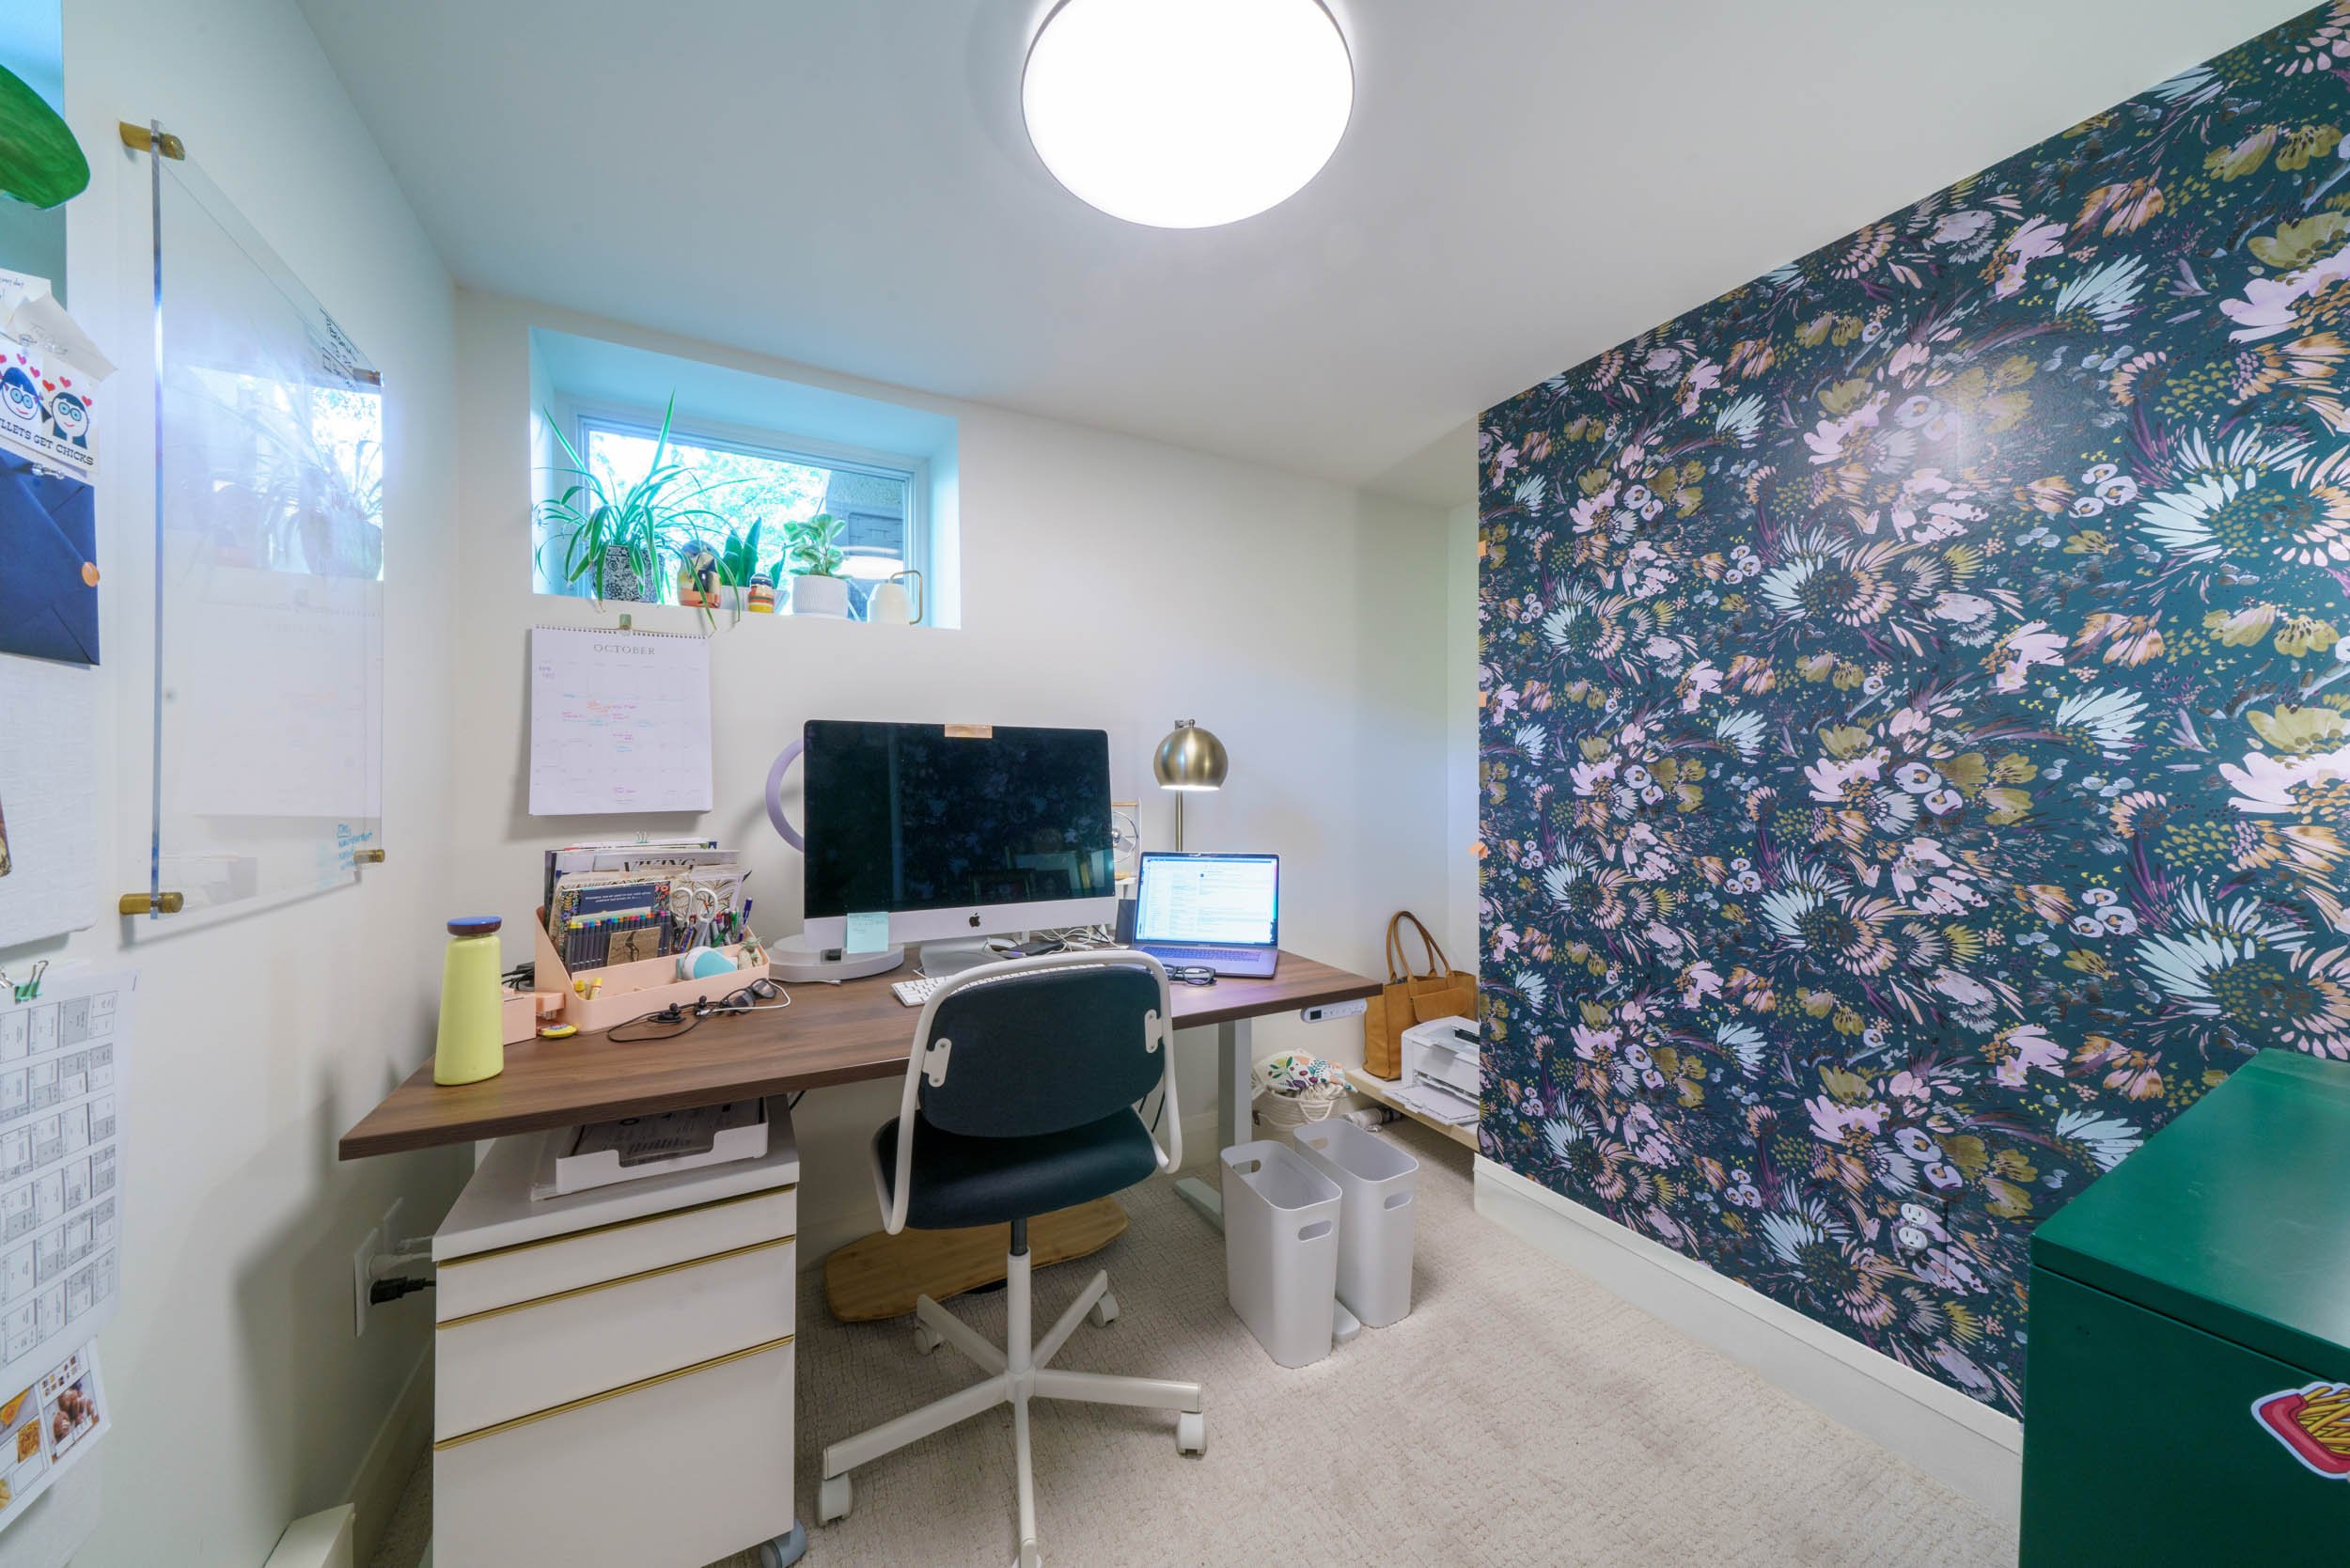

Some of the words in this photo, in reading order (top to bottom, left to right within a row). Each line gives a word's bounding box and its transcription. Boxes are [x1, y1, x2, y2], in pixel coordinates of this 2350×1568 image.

[0, 417, 32, 441] LLETS
[33, 433, 54, 449] GET
[55, 444, 94, 466] CHICKS
[593, 643, 655, 655] OCTOBER
